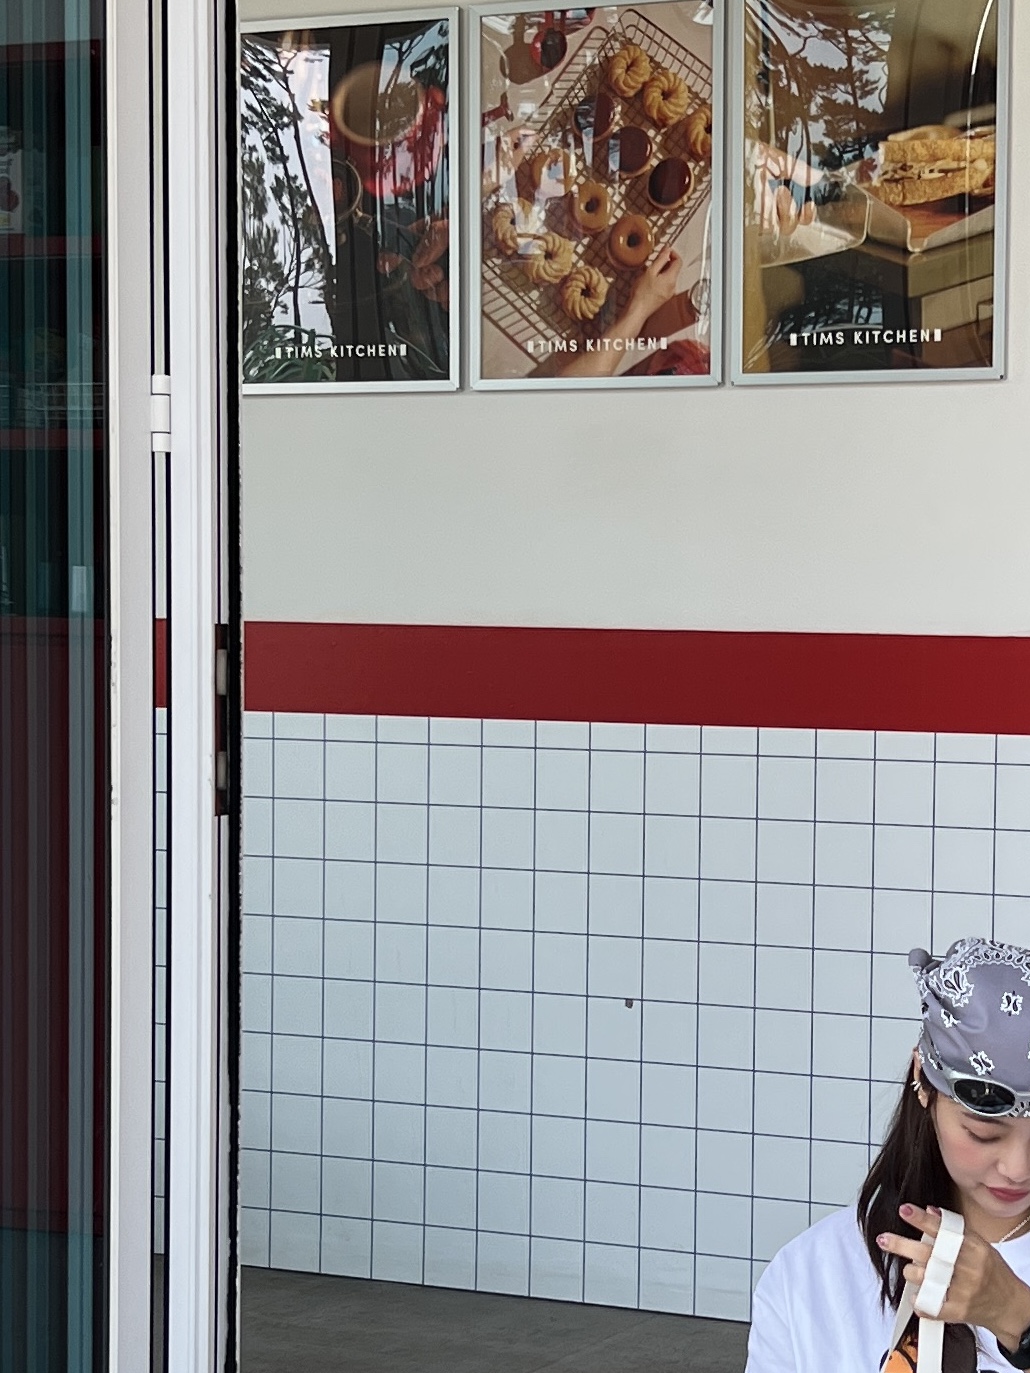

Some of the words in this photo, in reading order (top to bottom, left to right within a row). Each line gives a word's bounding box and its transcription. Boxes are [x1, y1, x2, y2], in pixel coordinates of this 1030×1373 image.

[538, 339, 578, 353] TIMS
[585, 337, 657, 352] KITCHEN
[801, 331, 845, 346] TIMS
[853, 328, 931, 345] KITCHEN
[285, 346, 323, 359] TIMS
[330, 344, 398, 359] KITCHEN
